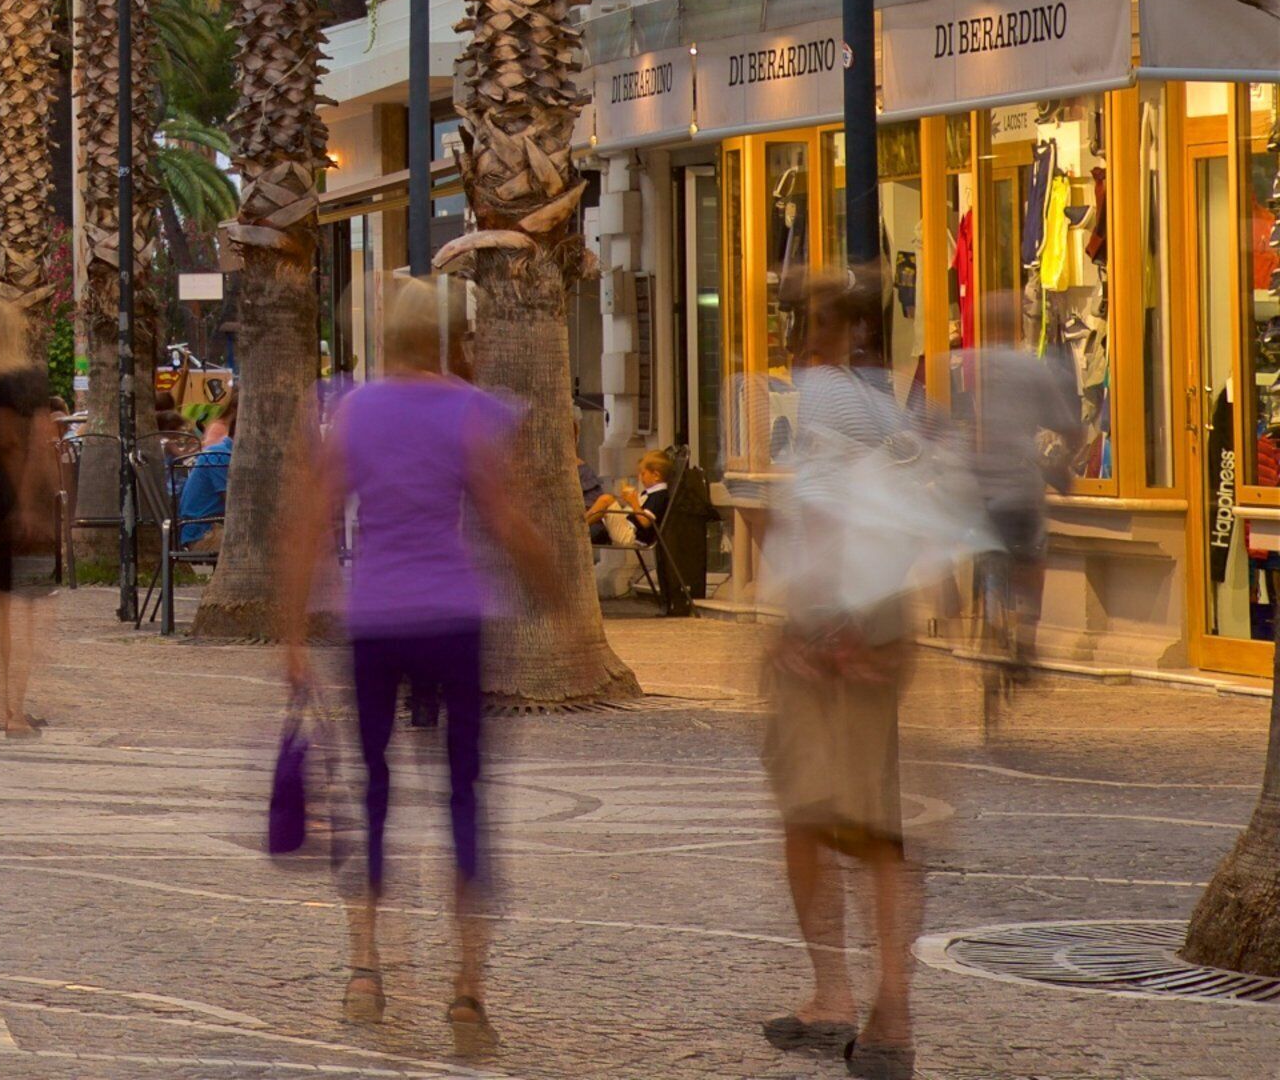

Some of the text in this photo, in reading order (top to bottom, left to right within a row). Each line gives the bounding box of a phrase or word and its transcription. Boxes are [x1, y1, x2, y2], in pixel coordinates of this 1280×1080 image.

[934, 2, 1067, 59] DI BERARDINO
[611, 62, 673, 104] DI BERARDINO
[729, 38, 836, 87] DI BERARDINO
[1003, 112, 1028, 131] LACOSTE
[1211, 449, 1236, 548] Happiness
